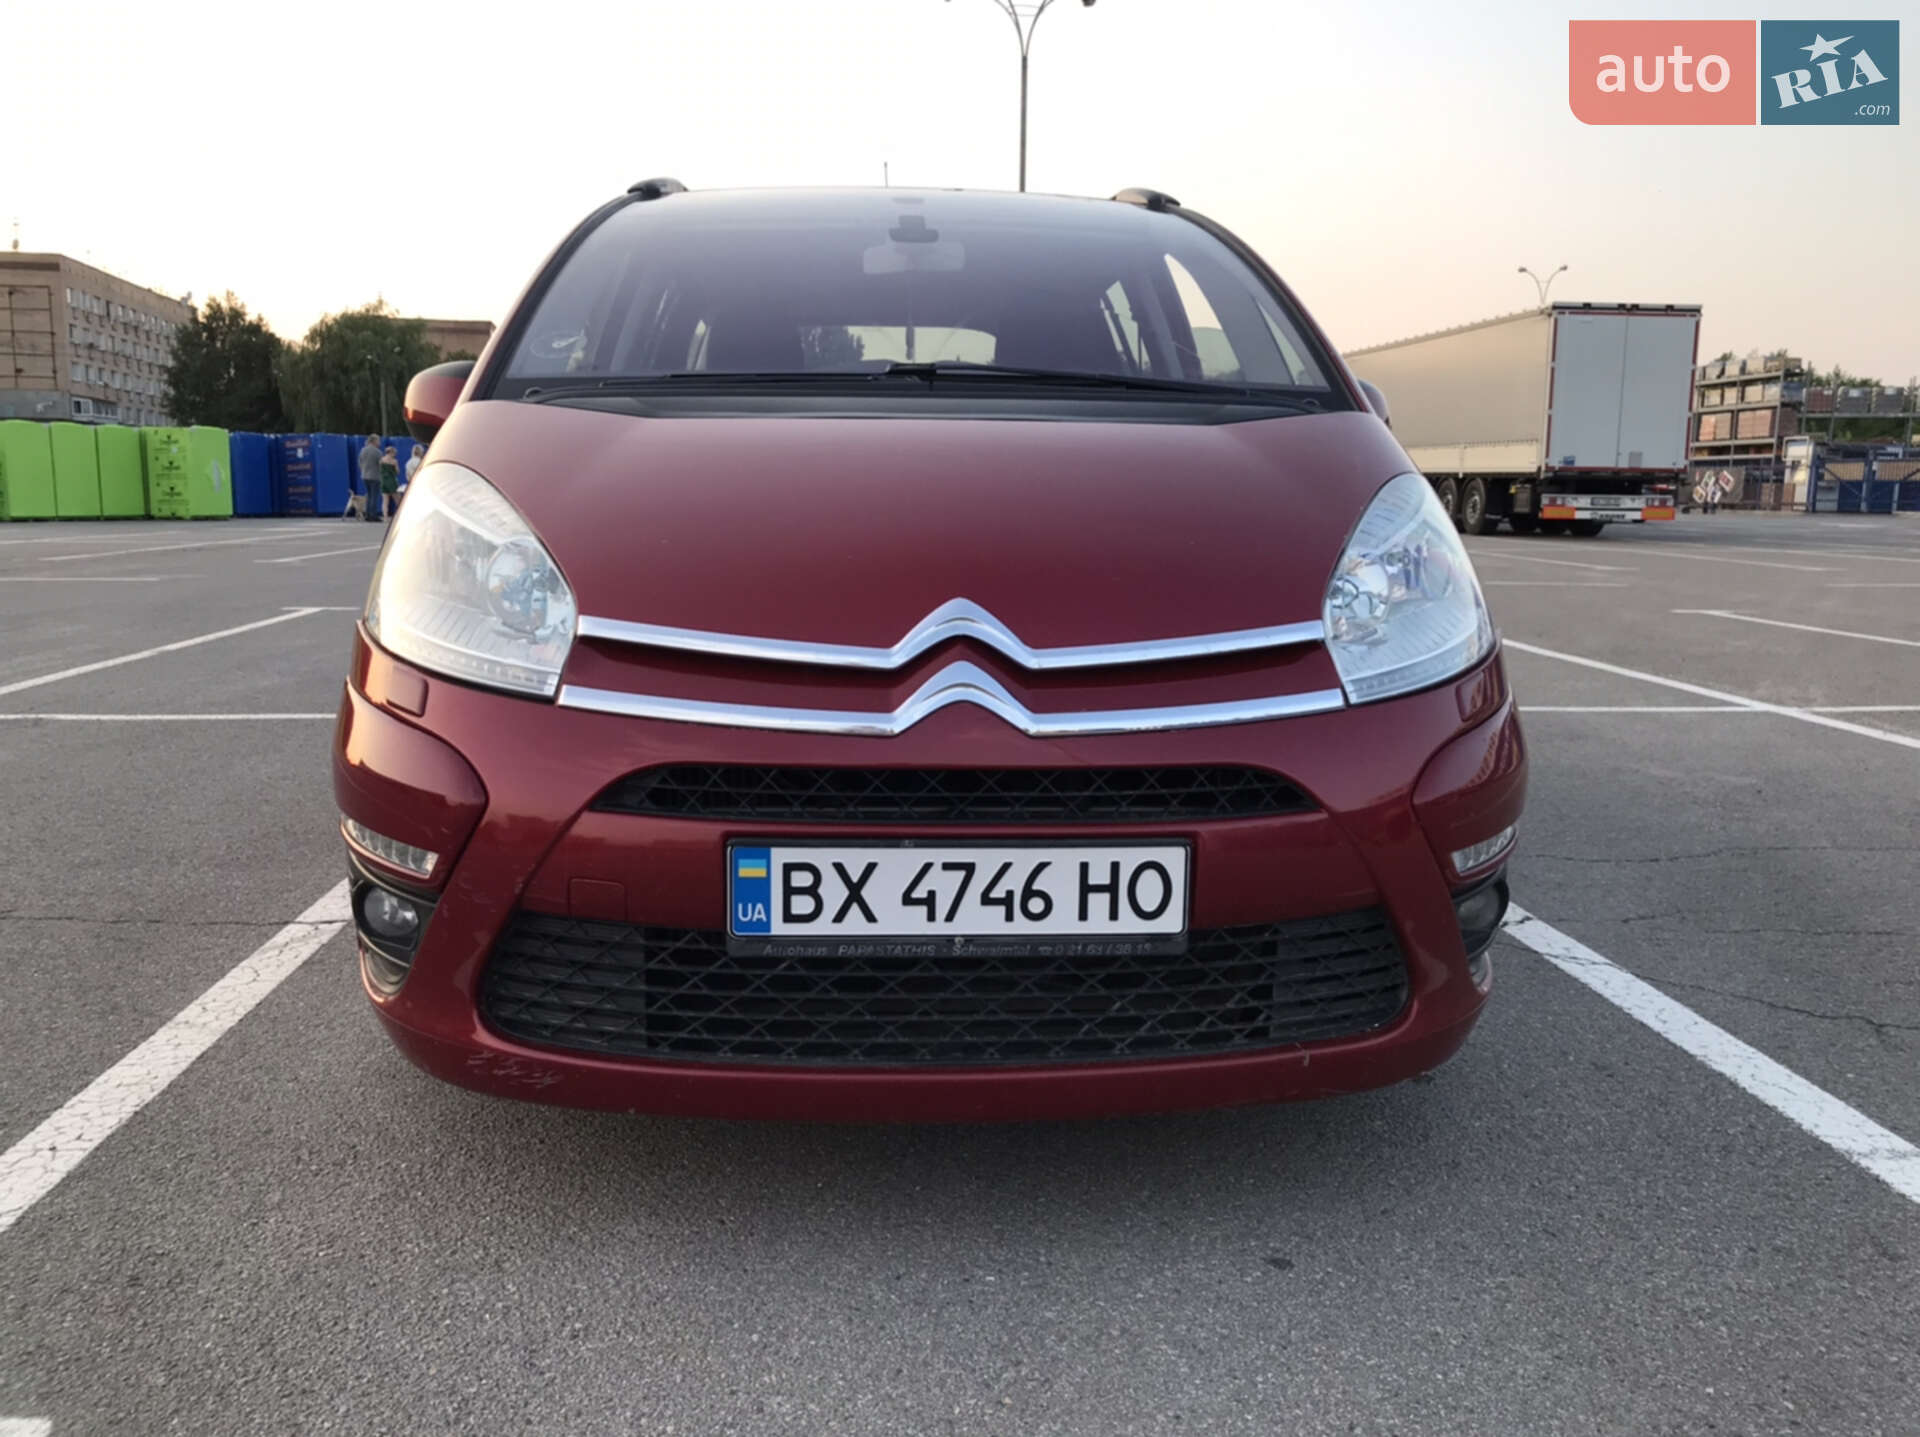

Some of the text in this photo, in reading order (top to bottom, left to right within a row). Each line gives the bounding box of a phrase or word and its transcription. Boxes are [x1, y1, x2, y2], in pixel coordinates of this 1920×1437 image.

[738, 903, 767, 922] UA
[781, 860, 1173, 924] BX 4746 HO
